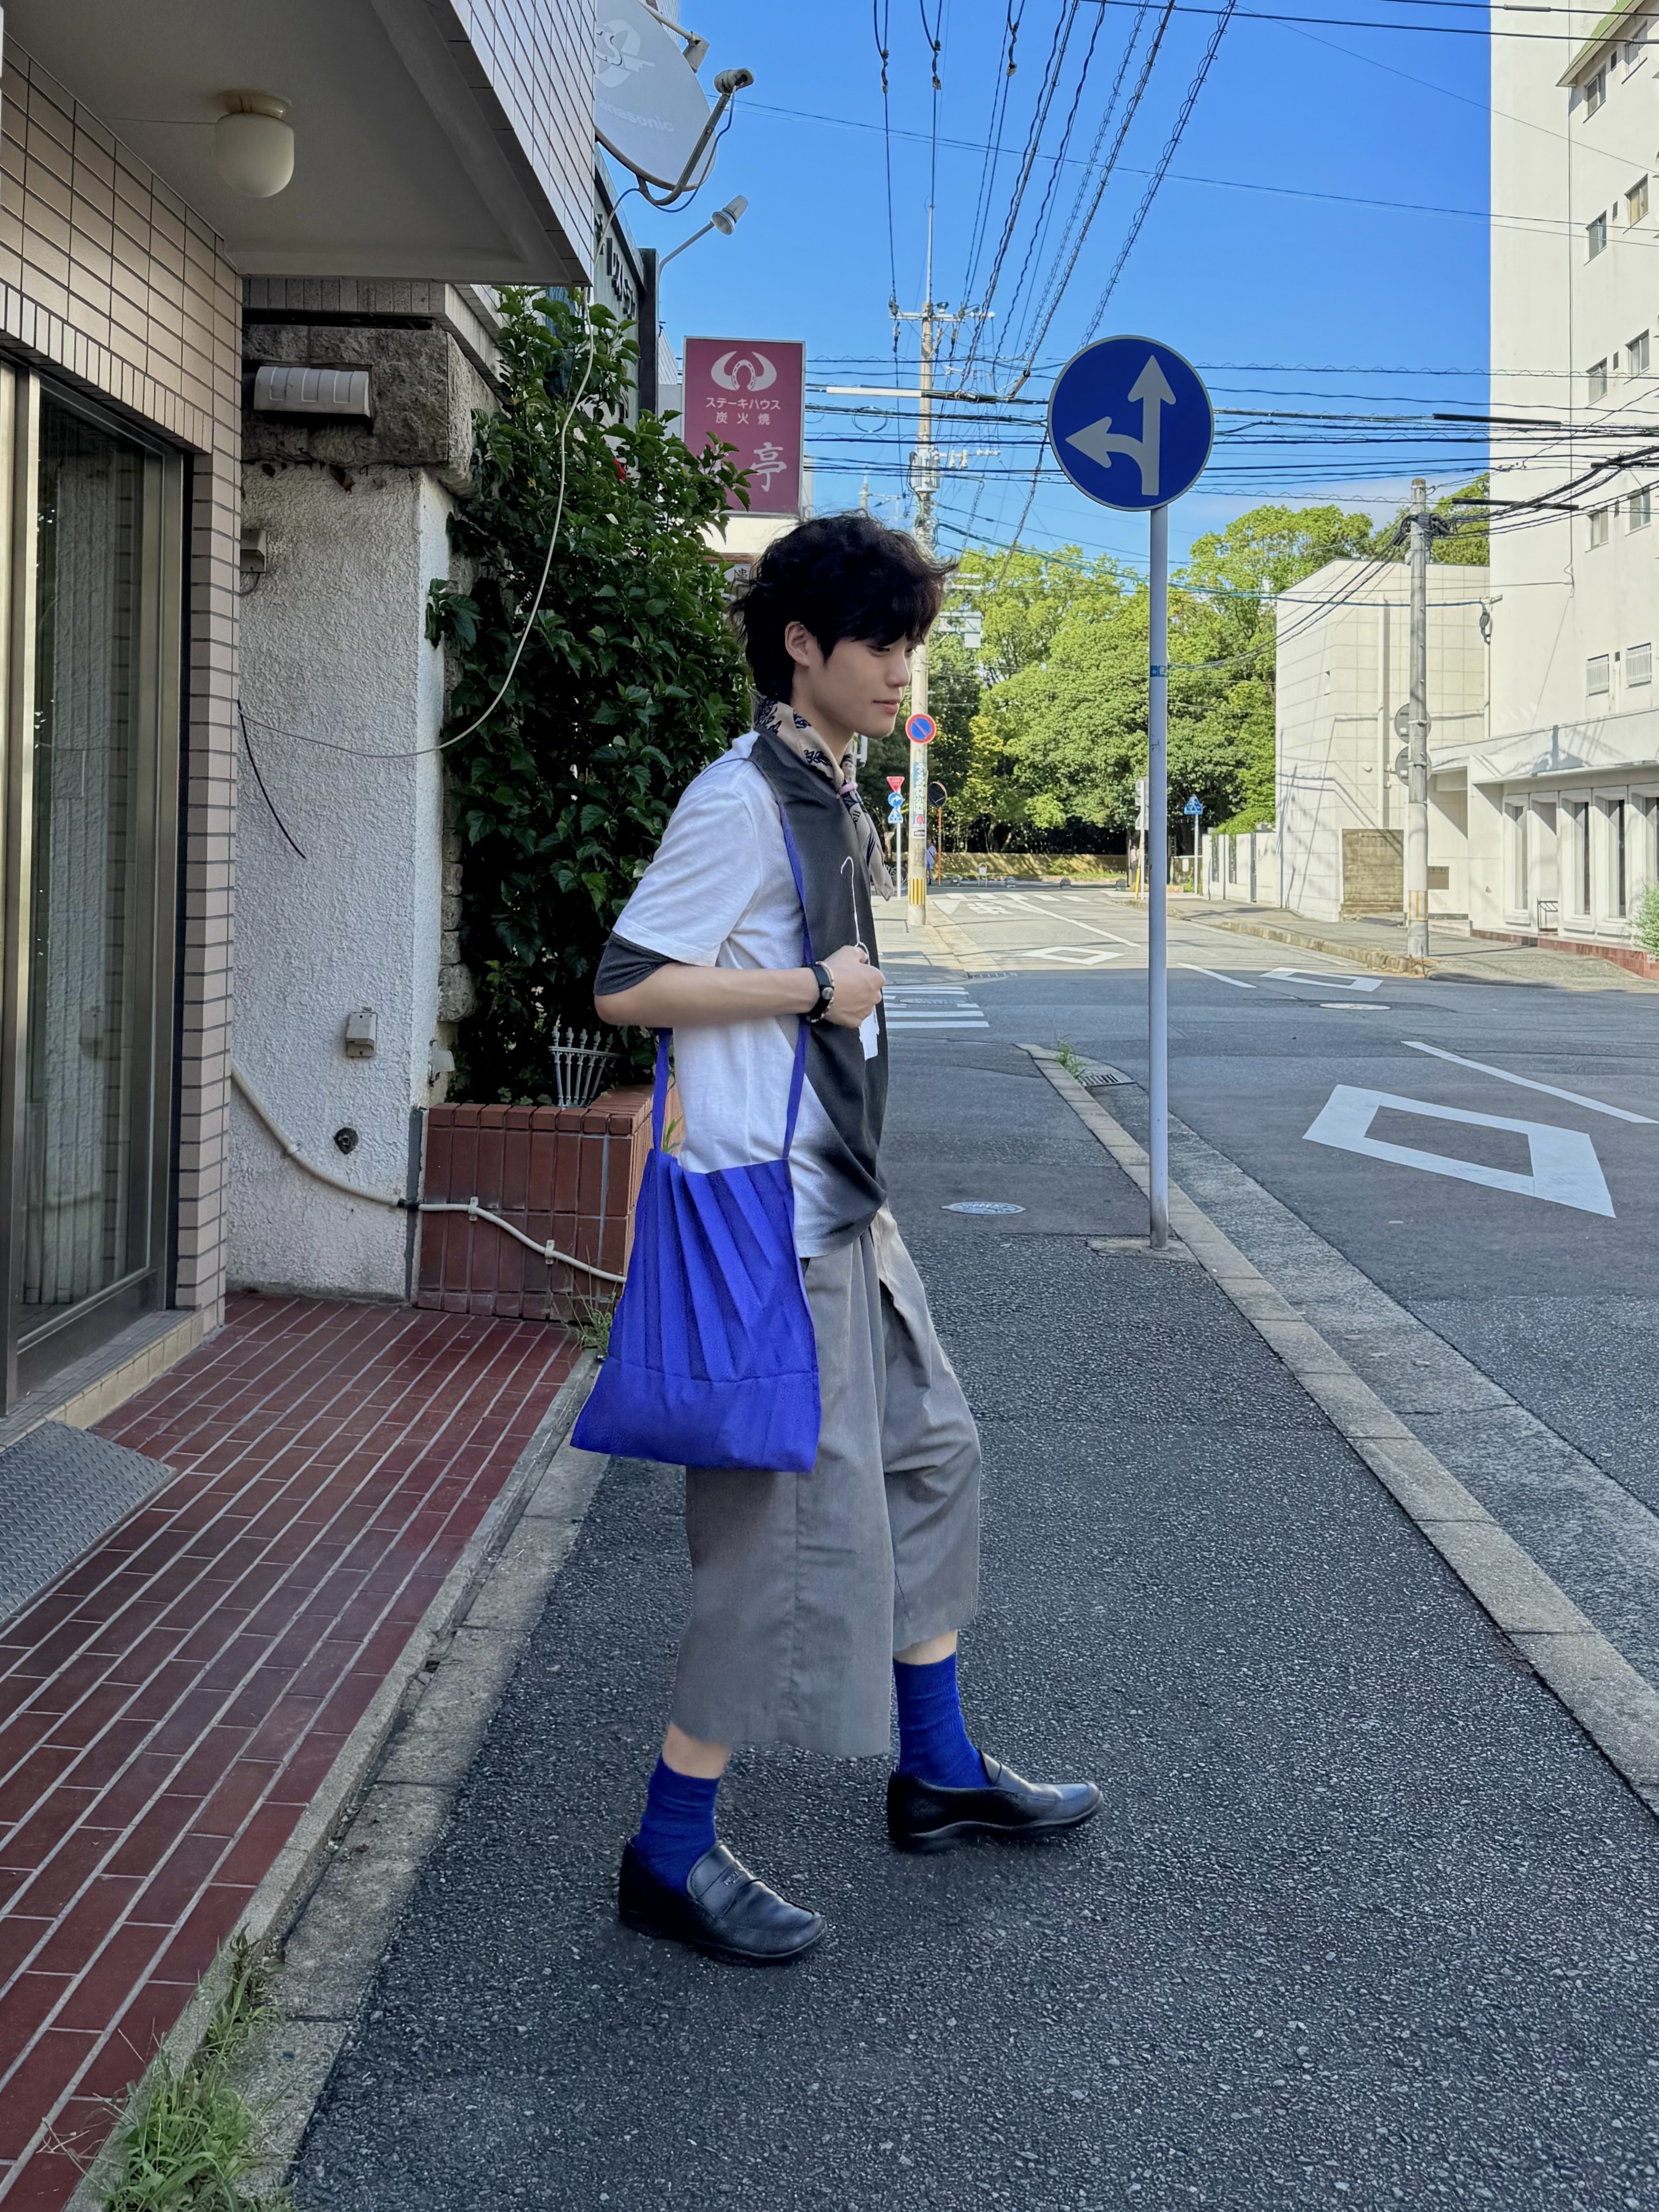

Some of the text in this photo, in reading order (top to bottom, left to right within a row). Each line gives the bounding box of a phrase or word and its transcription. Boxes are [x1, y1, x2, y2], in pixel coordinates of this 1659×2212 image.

[596, 97, 675, 132] anasonic
[705, 397, 781, 410] ステーキハウス
[716, 411, 770, 426] 炭火焼
